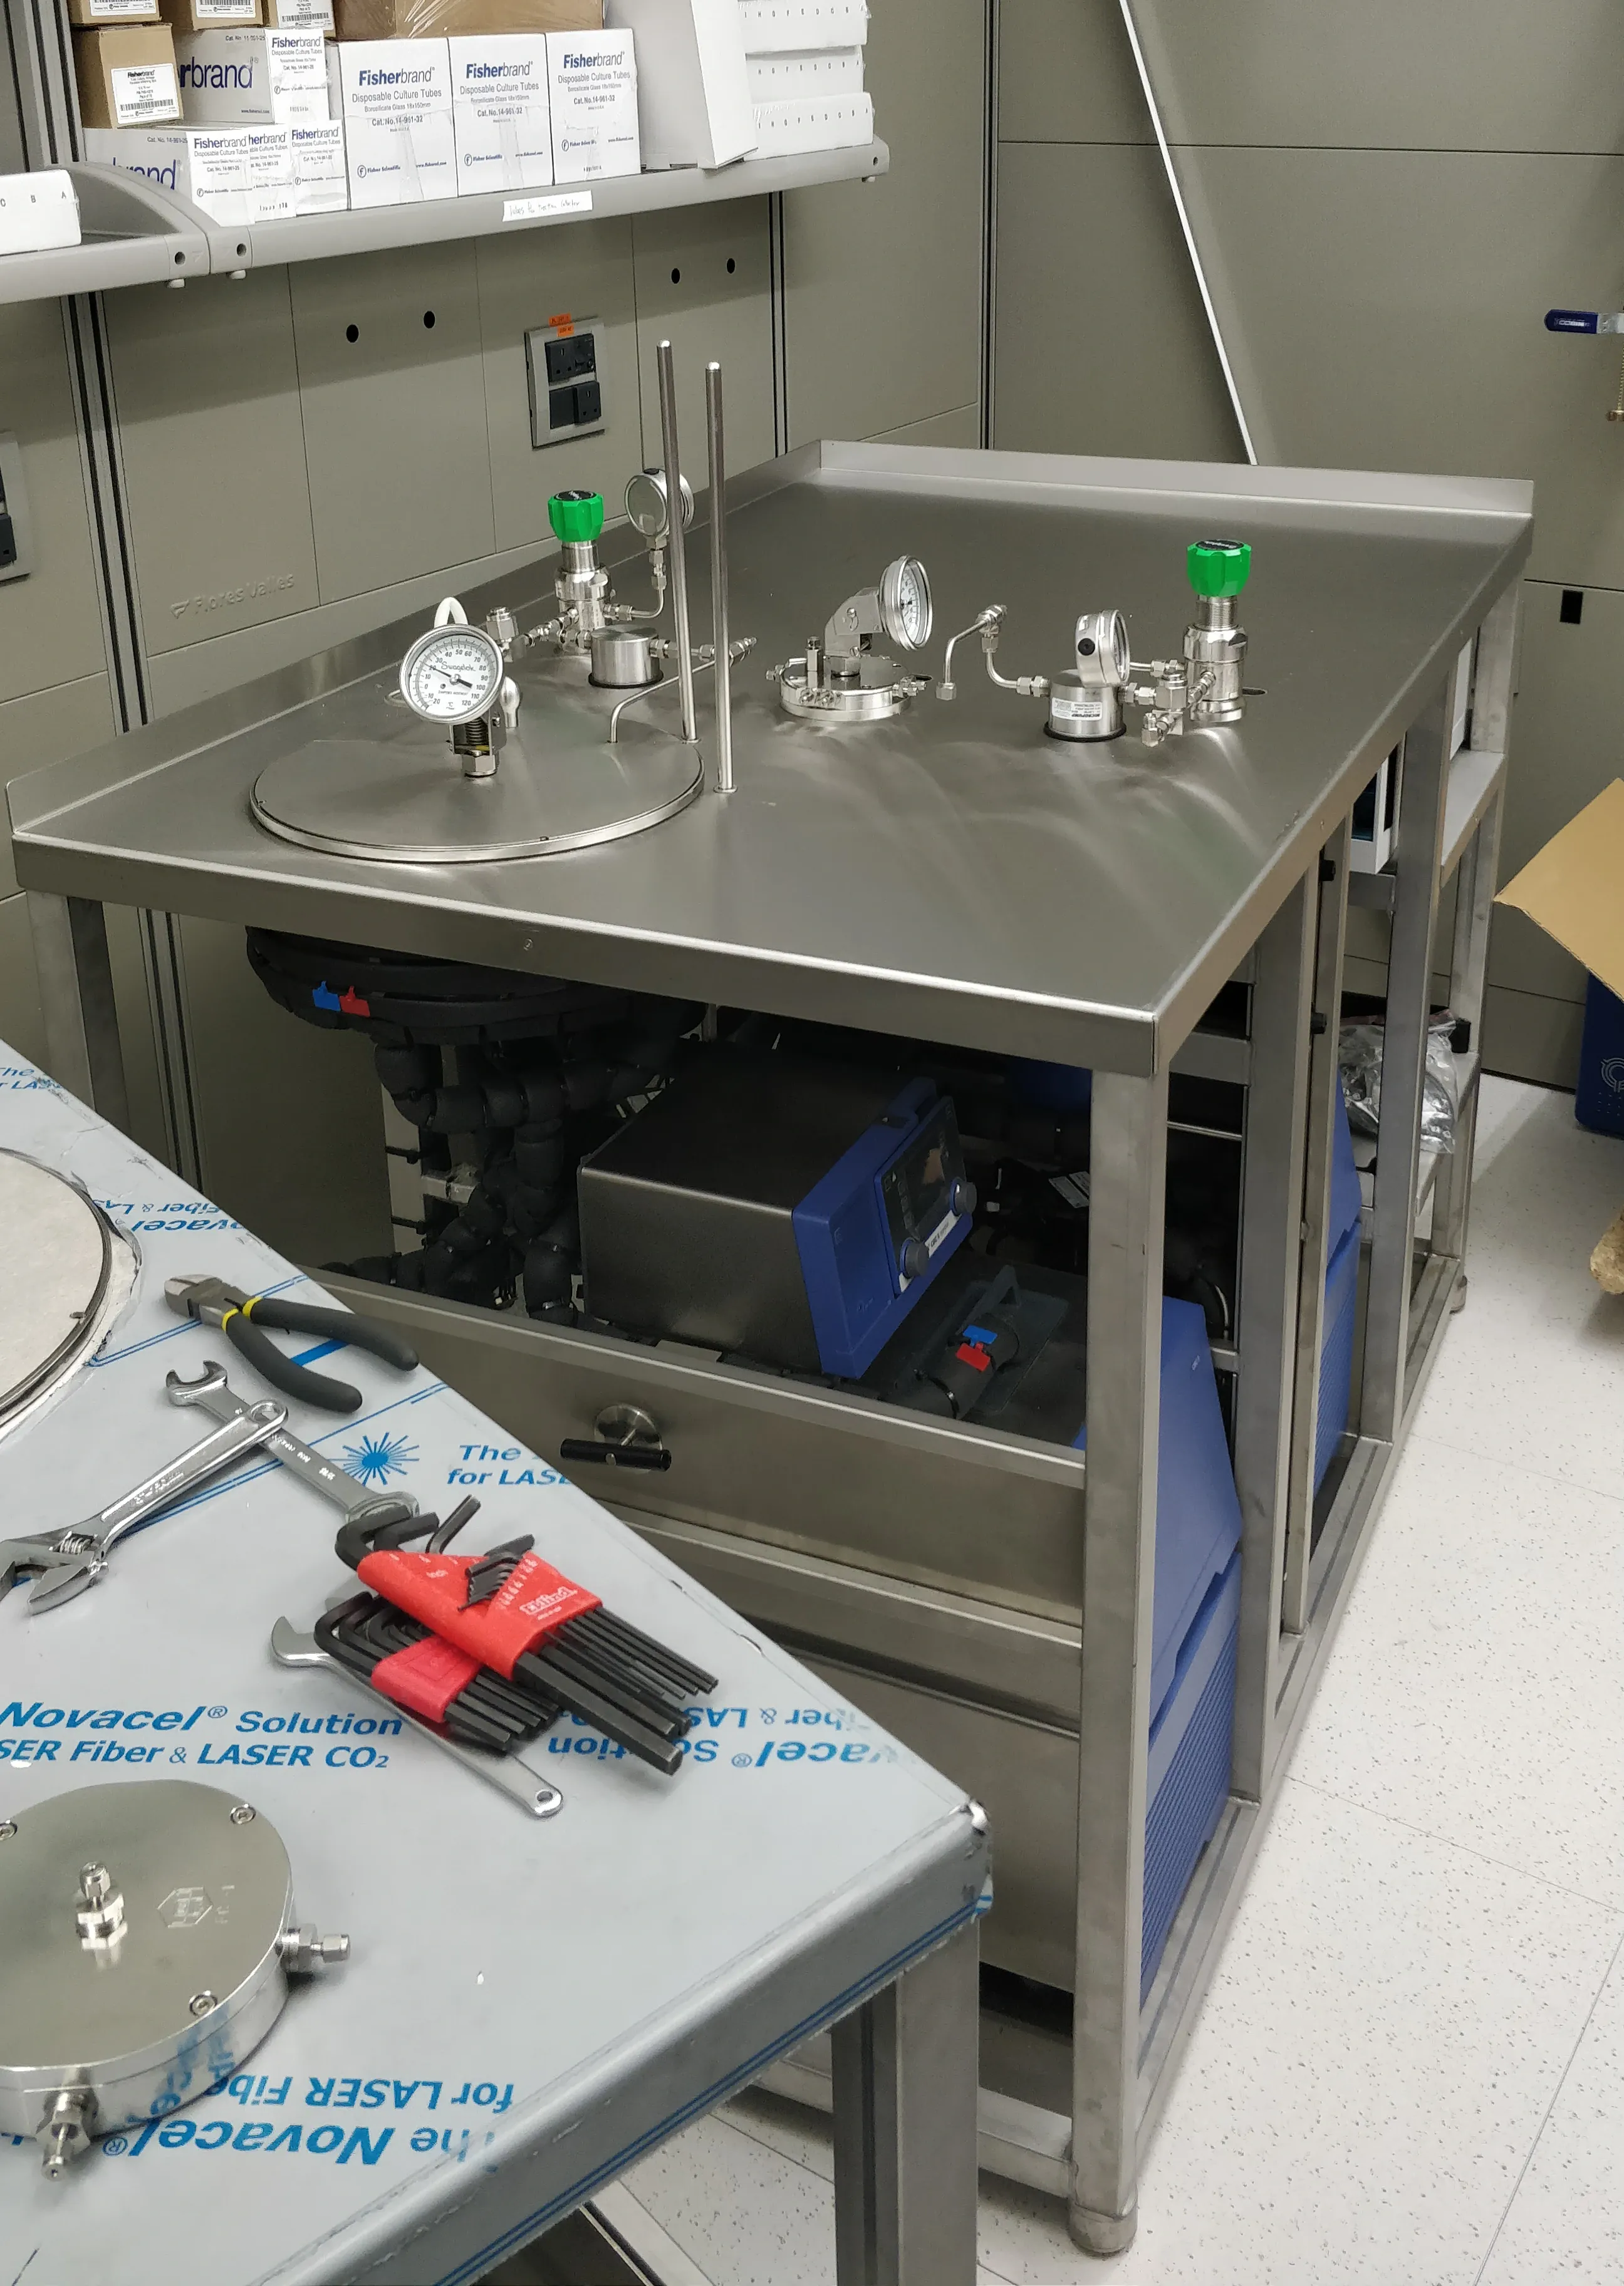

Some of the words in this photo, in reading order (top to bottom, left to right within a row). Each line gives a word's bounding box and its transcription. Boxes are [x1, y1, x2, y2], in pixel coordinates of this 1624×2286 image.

[271, 36, 321, 48] Fisherbrand
[563, 51, 623, 69] Fisherbrand
[359, 66, 432, 86] Fisherbrand
[466, 61, 531, 79] Fisherbrand
[558, 73, 590, 85] Disposable
[591, 72, 612, 81] Culture
[613, 71, 631, 79] Tubes
[352, 92, 392, 103] Disposable
[393, 91, 419, 100] Culture
[420, 88, 442, 97] Tubes
[460, 85, 495, 95] Disposable
[496, 83, 519, 92] Culture
[520, 82, 539, 90] Tubes
[194, 135, 247, 149] Fisherbrand
[249, 132, 286, 145] herbrand
[291, 127, 340, 140] Fisherbrand
[31, 195, 36, 203] B
[61, 191, 66, 199] A
[459, 1444, 521, 1461] The
[447, 1468, 493, 1485] for
[236, 1711, 403, 1736] Solution
[759, 1707, 778, 1725] &
[70, 1740, 165, 1763] Fiber
[169, 1746, 187, 1764] &
[197, 1743, 314, 1767] LASER
[304, 2076, 443, 2110] LASER
[450, 2082, 514, 2114] for
